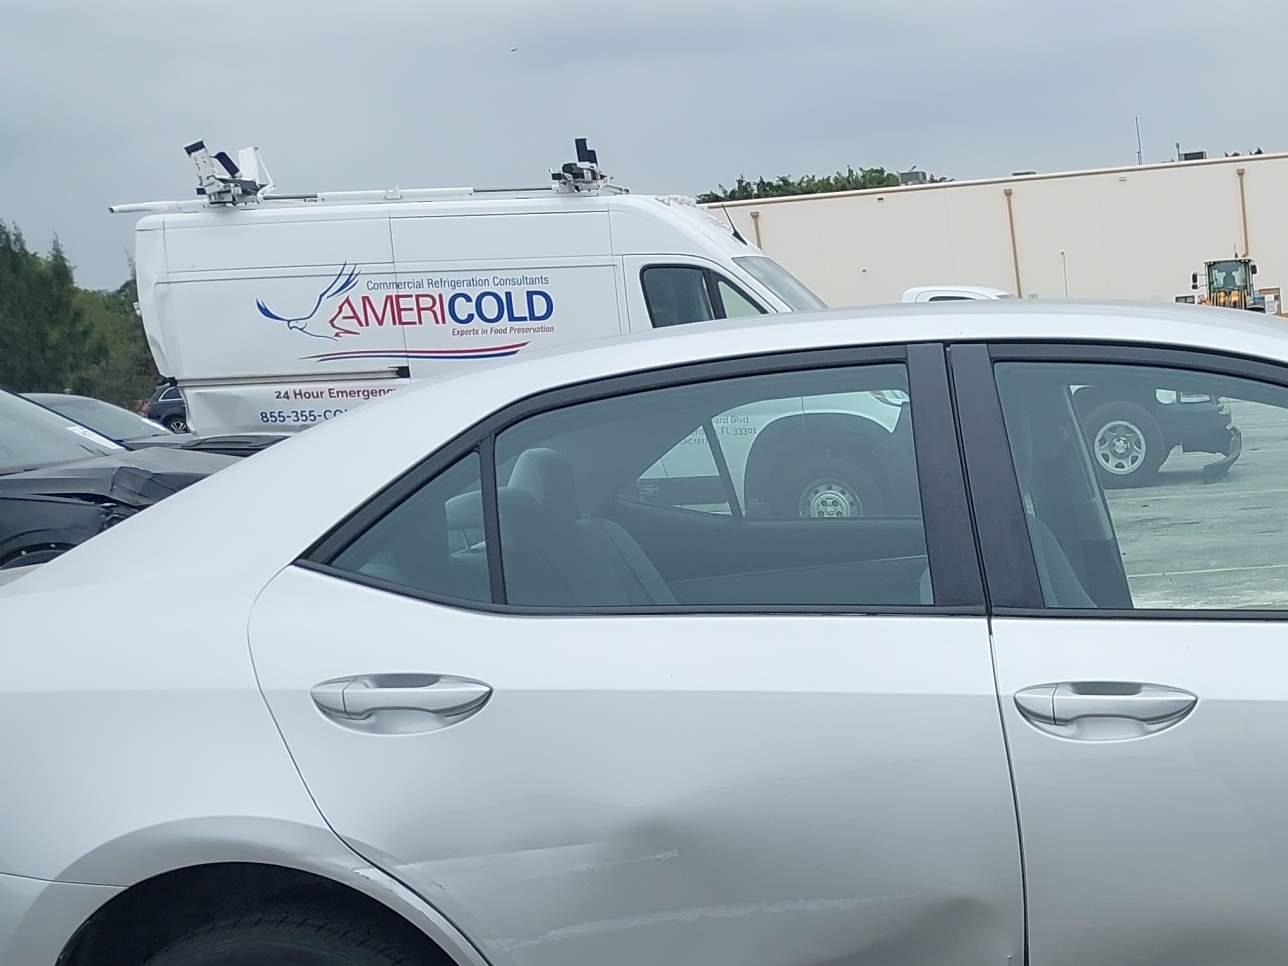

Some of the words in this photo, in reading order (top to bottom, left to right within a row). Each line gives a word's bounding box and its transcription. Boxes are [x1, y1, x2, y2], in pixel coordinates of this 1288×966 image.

[366, 278, 424, 291] Commercial
[427, 275, 490, 290] Refrigeration
[492, 275, 550, 287] Consultants
[329, 290, 554, 334] AMERICOLD
[451, 327, 479, 337] Experts
[480, 327, 488, 336] in
[489, 326, 508, 335] Food
[509, 325, 555, 335] Preservation
[274, 390, 290, 400] 24
[293, 389, 325, 400] Hour
[328, 387, 396, 401] Emergenc
